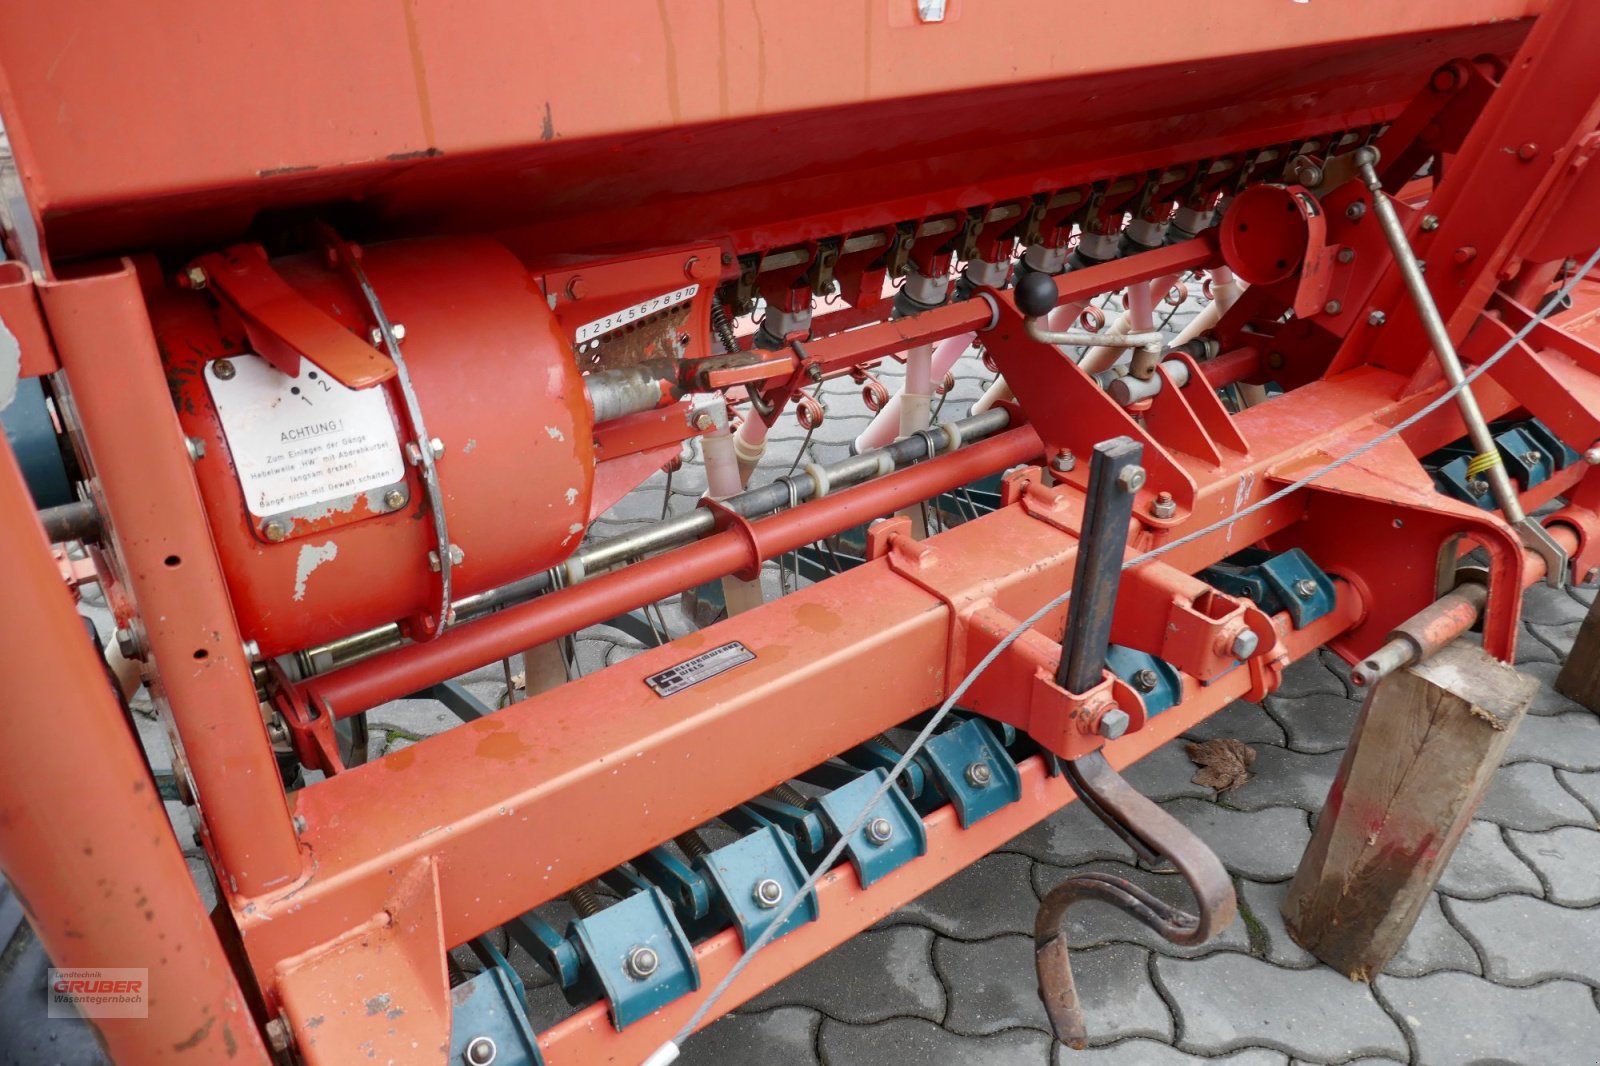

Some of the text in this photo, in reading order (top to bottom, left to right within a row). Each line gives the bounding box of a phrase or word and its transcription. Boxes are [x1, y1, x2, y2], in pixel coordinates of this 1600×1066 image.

[582, 287, 696, 338] 1 2 3 4 5 6 7 8 9 10
[301, 380, 331, 406] 1 2
[266, 455, 284, 464] Zum
[288, 446, 322, 458] Einlegen
[326, 440, 338, 449] der
[323, 454, 335, 462] mit
[290, 470, 323, 483] langsam
[289, 491, 308, 501] nicht
[312, 486, 325, 495] mit
[328, 478, 355, 490] Gewalt
